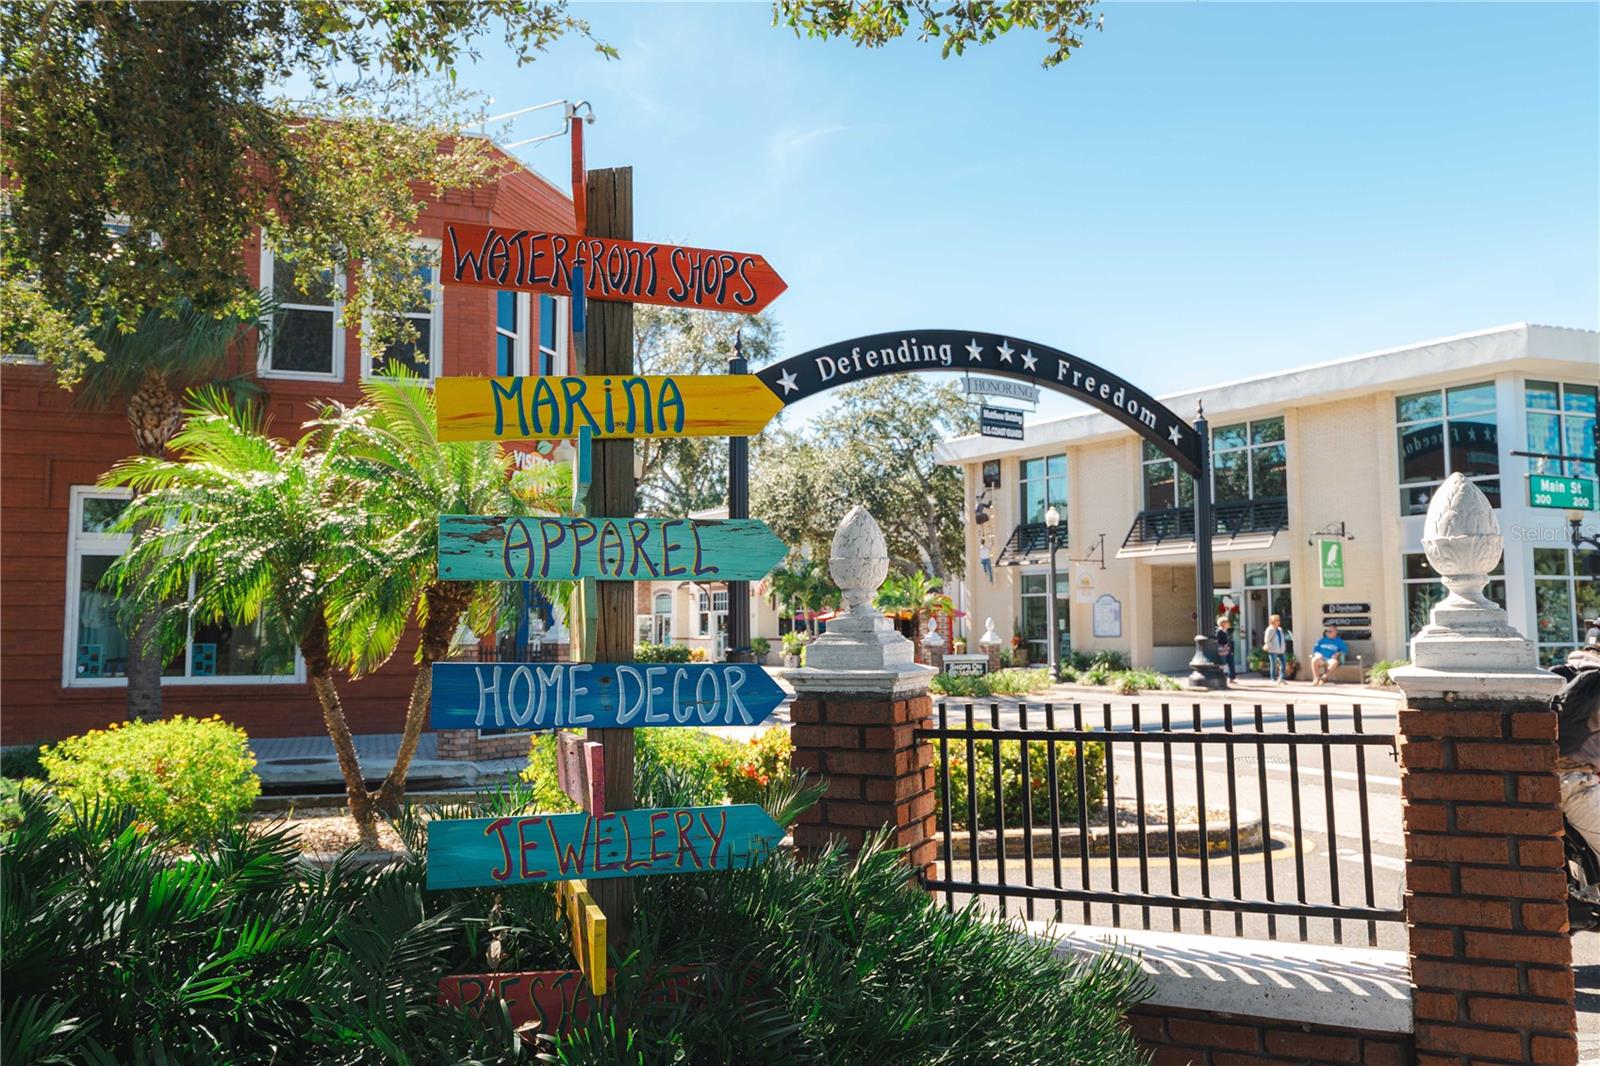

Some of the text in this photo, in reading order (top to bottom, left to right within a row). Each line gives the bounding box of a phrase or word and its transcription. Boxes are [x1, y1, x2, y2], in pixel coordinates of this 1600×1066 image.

[668, 247, 758, 306] SHOPS
[815, 338, 1158, 430] Defending Freedom
[974, 379, 1033, 398] HONORING
[1535, 494, 1590, 507] 300 200
[1540, 479, 1582, 494] Main St
[503, 518, 720, 579] APPAREL
[475, 664, 754, 726] HOME DECOR
[484, 810, 727, 881] JEWELERY
